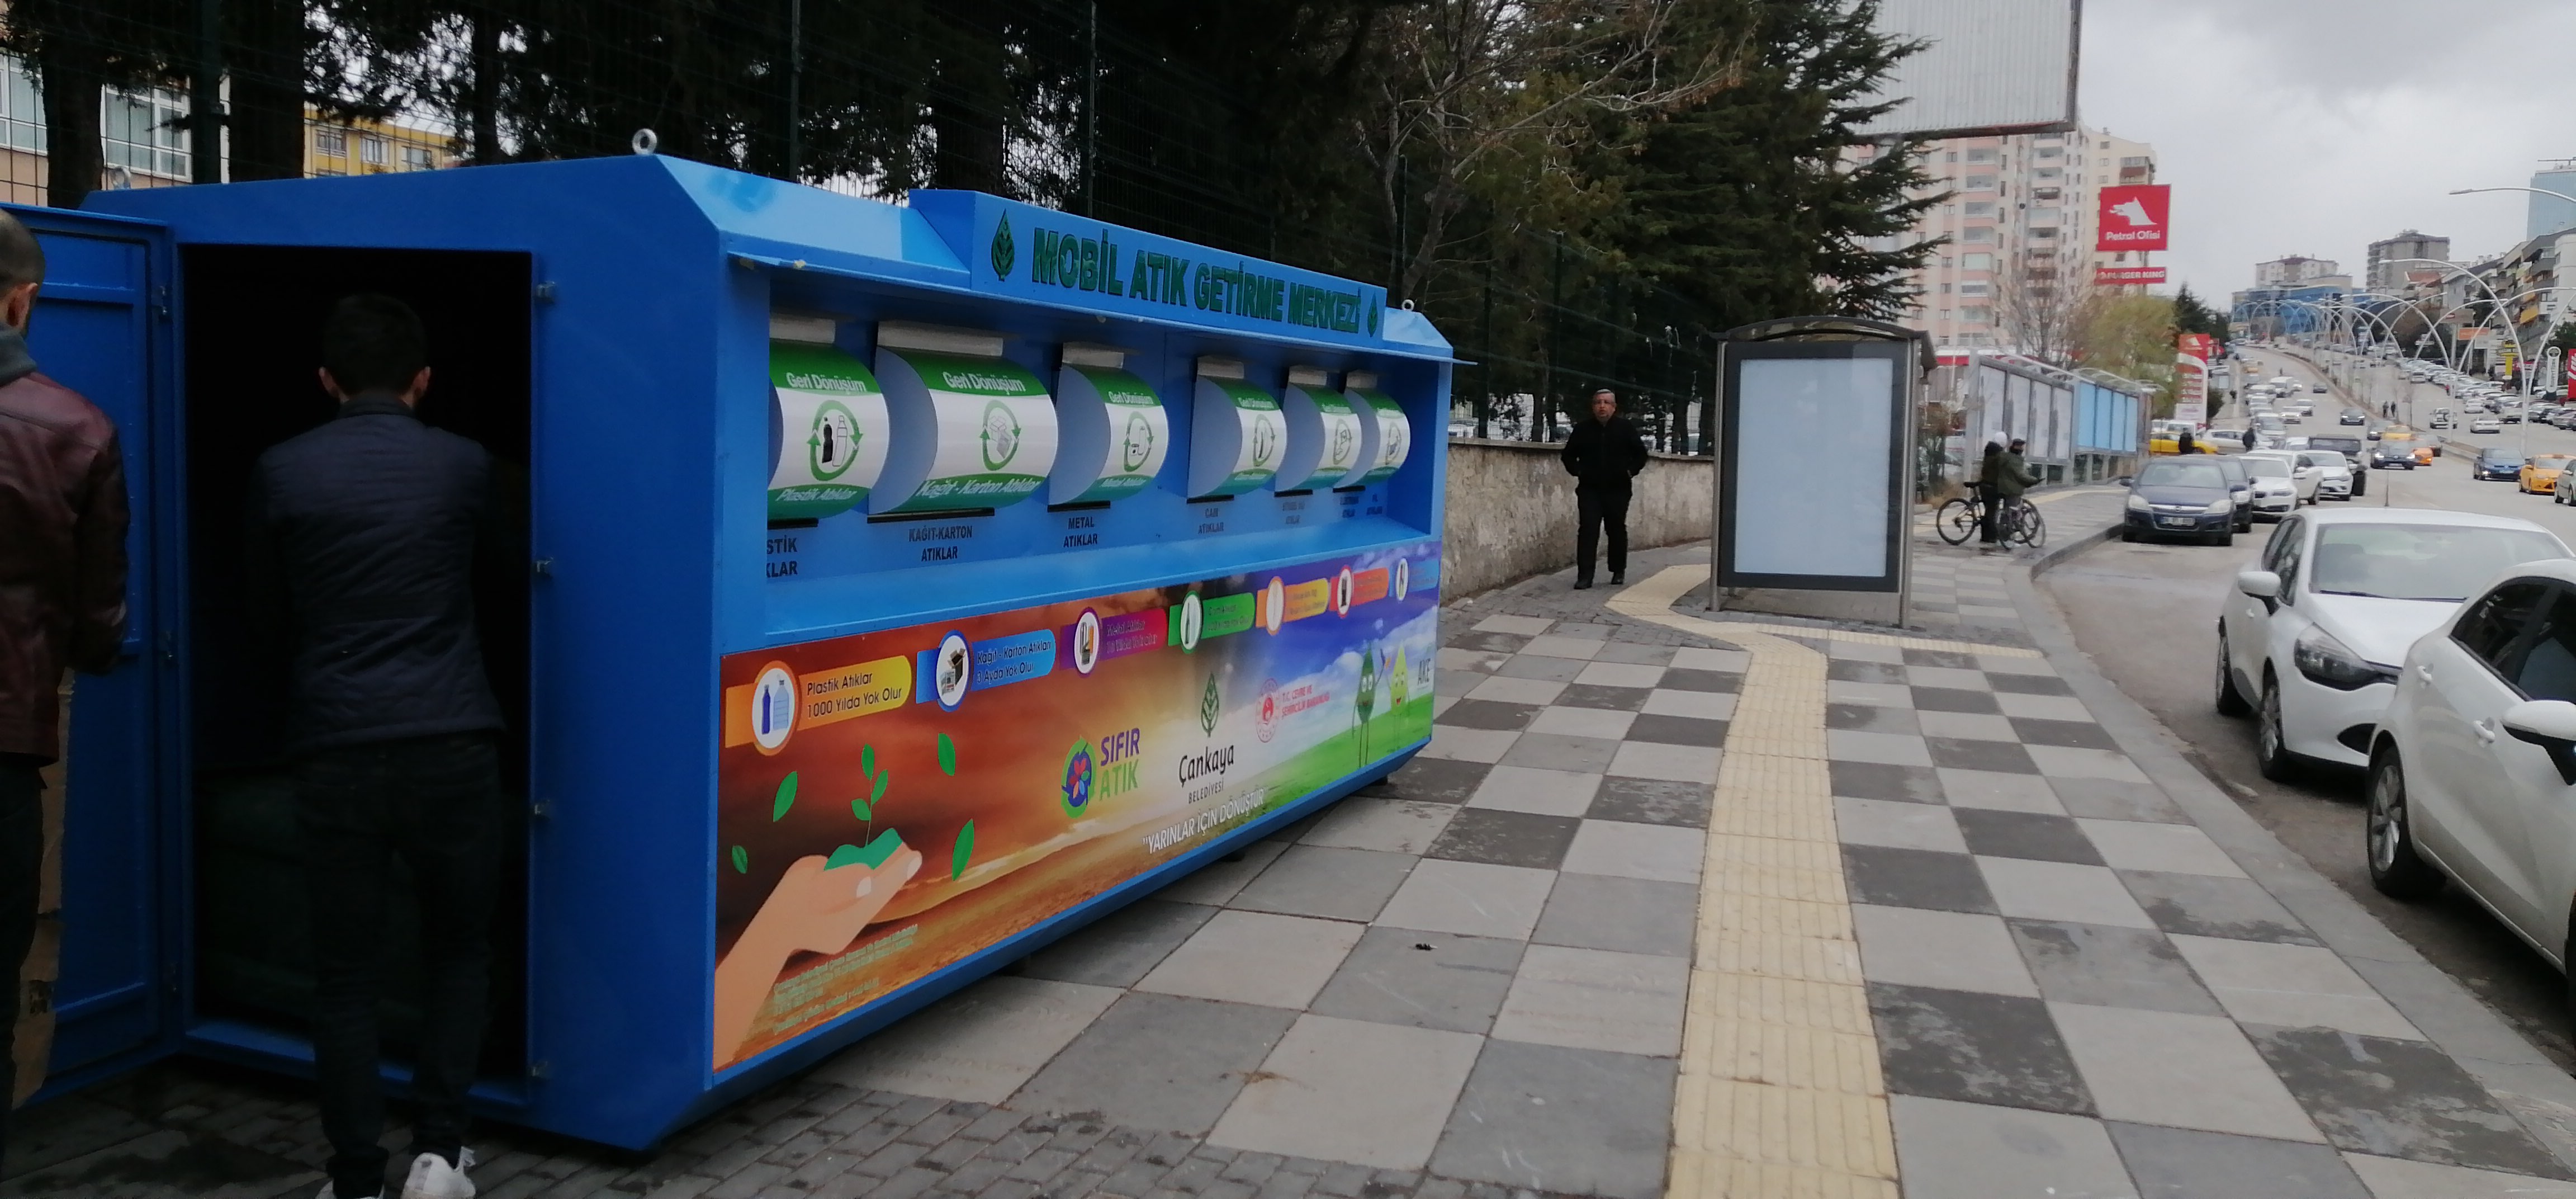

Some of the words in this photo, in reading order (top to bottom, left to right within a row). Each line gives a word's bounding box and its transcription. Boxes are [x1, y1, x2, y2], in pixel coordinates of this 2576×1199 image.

[2106, 231, 2135, 240] Petrol
[2137, 230, 2160, 239] Ofisi
[1032, 227, 1123, 296] MOBİL
[1129, 249, 1190, 306] ATIK
[1194, 261, 1285, 322] GETİRME
[1287, 281, 1361, 334] MERKEZİ
[785, 372, 812, 389] Geri
[943, 371, 971, 389] Geri
[1068, 516, 1095, 530] METAL
[908, 525, 973, 542] KAĞIT-KARTON
[1063, 533, 1098, 548] ATIKLAR
[921, 545, 958, 562] ATIKLAR
[977, 648, 998, 665] Kağıt
[1003, 645, 1027, 659] Karton
[807, 677, 839, 696] Plastik
[841, 672, 873, 690] Atıklar
[977, 671, 982, 683] 3
[984, 669, 1003, 685] Ayda
[1005, 665, 1017, 677] Yok
[807, 700, 832, 719] 1000
[836, 696, 860, 712] Yılda
[863, 691, 879, 705] Yok
[882, 687, 902, 701] Olur
[1100, 728, 1141, 767] SIFIR
[1178, 744, 1234, 788] Çankaya
[1099, 759, 1139, 801] ATIK
[1188, 777, 1224, 804] BELEDİYESİ
[1197, 804, 1218, 836] İÇİN
